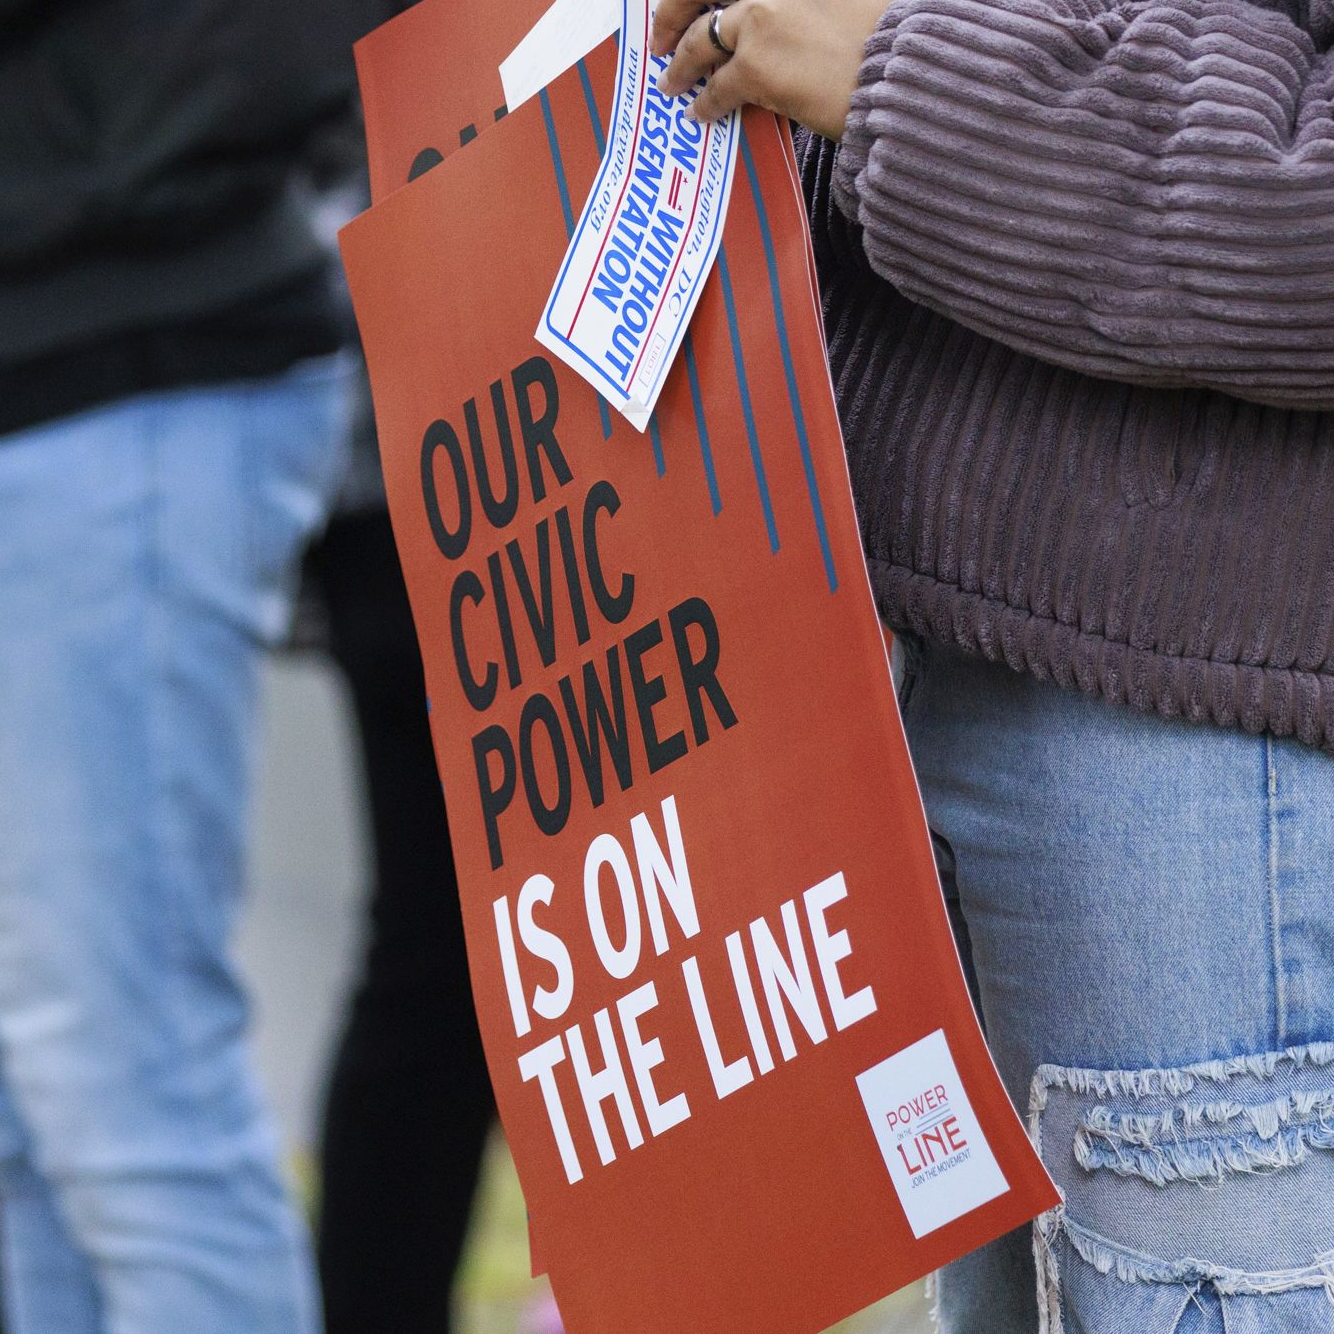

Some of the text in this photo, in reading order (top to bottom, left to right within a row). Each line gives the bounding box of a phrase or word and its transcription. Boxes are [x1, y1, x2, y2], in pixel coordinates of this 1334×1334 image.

[590, 47, 638, 234] www.dcvote.org
[604, 209, 685, 383] WITHOUT
[669, 267, 693, 318] DC
[420, 355, 574, 561] OUR
[449, 479, 636, 712] CIVIC
[470, 596, 740, 871] POWER
[492, 794, 702, 1039] IS ON
[517, 870, 878, 1186] THE LINE
[886, 1084, 949, 1132] POWER
[896, 1116, 968, 1176] LINE
[911, 1148, 972, 1189] JOIN THE MOVEMENT
